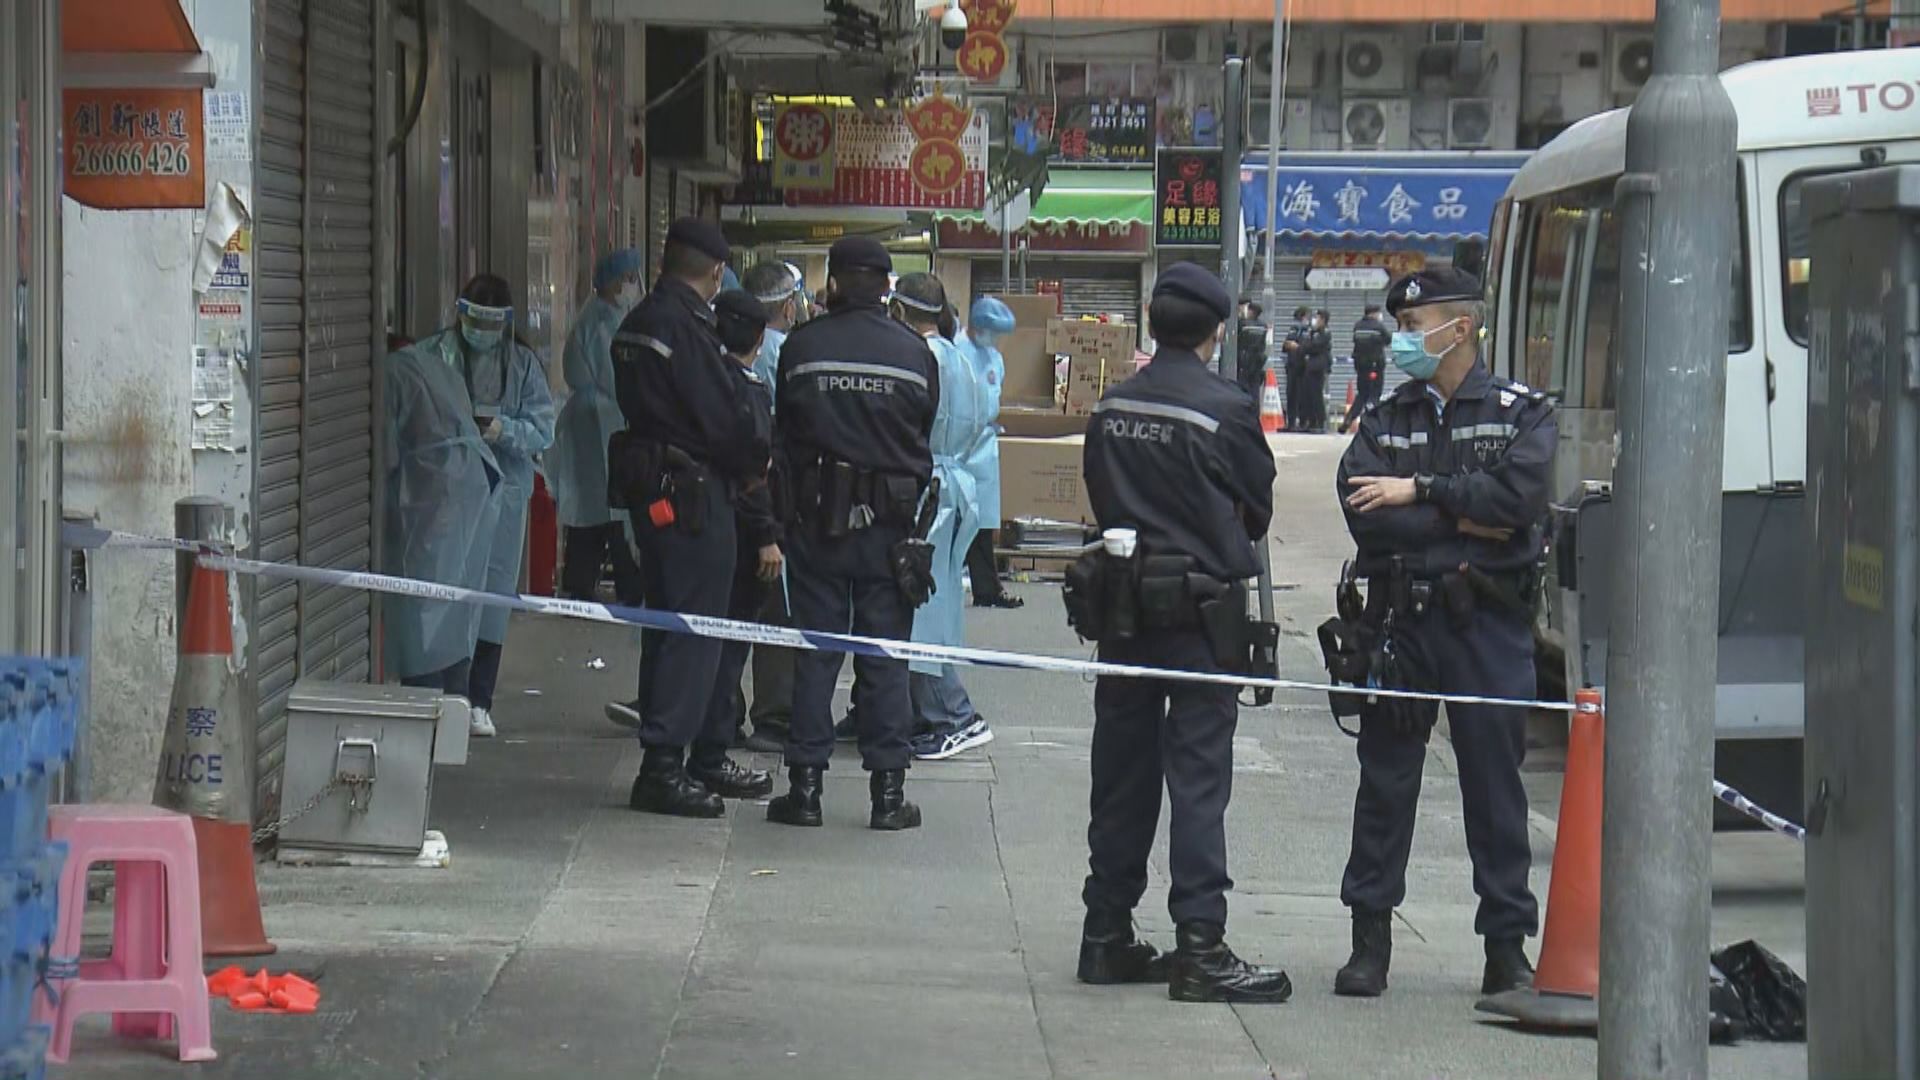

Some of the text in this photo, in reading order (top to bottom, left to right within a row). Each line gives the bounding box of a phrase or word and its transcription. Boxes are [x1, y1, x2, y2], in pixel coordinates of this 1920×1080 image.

[1847, 80, 1920, 113] TO
[784, 112, 825, 154] 粥
[1091, 115, 1146, 128] 2321 3451
[73, 143, 190, 175] 26666426
[921, 146, 954, 184] 押
[1281, 179, 1468, 225] 海寶食品
[1163, 207, 1220, 226] 美容足浴
[1163, 226, 1220, 240] 23213451
[829, 376, 883, 393] POLICE
[1104, 418, 1160, 441] POLICE
